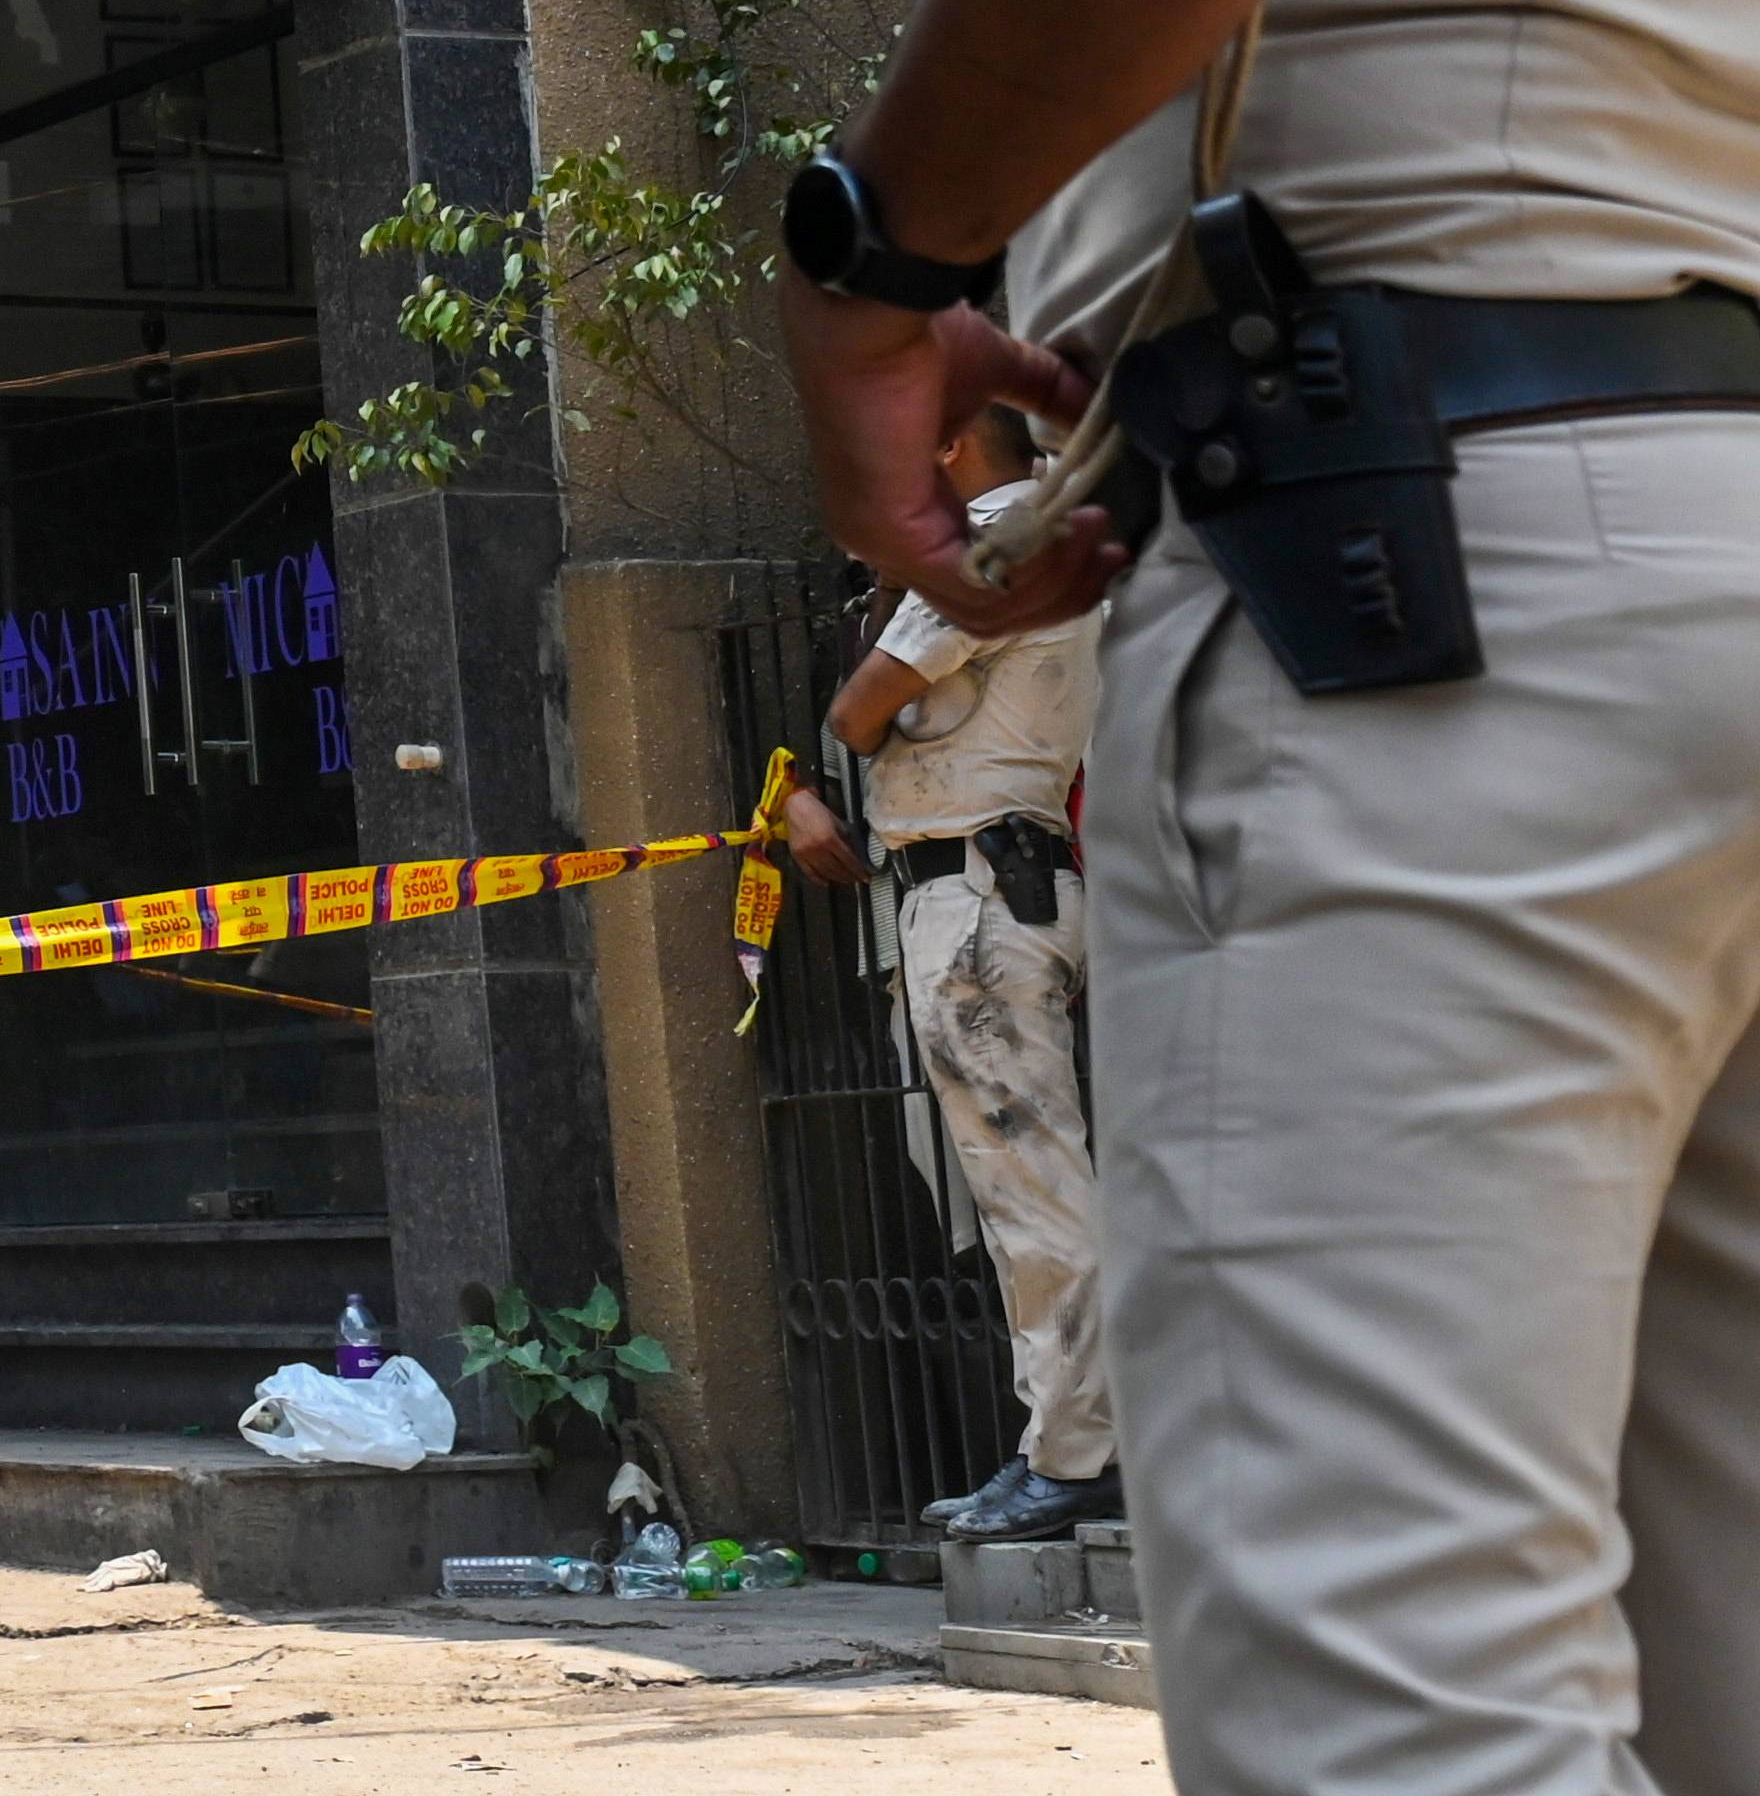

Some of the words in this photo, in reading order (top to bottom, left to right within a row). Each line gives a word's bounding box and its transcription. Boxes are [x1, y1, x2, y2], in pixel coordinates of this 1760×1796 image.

[7, 733, 84, 824] B&B
[409, 865, 444, 880] LINE
[572, 860, 621, 881] DELHI
[310, 877, 370, 901] POLICE
[402, 878, 448, 899] CROSS
[740, 873, 756, 913] NOT
[140, 899, 177, 919] LINE
[400, 899, 430, 917] NOT
[434, 895, 455, 911] DO
[749, 882, 771, 935] CROSS
[317, 903, 367, 926] DELHI
[737, 912, 749, 935] DO
[34, 916, 101, 938] POLICE
[141, 916, 192, 936] CROSS
[54, 937, 105, 960] DELHI
[142, 937, 172, 955] NOT
[176, 933, 197, 949] DO
